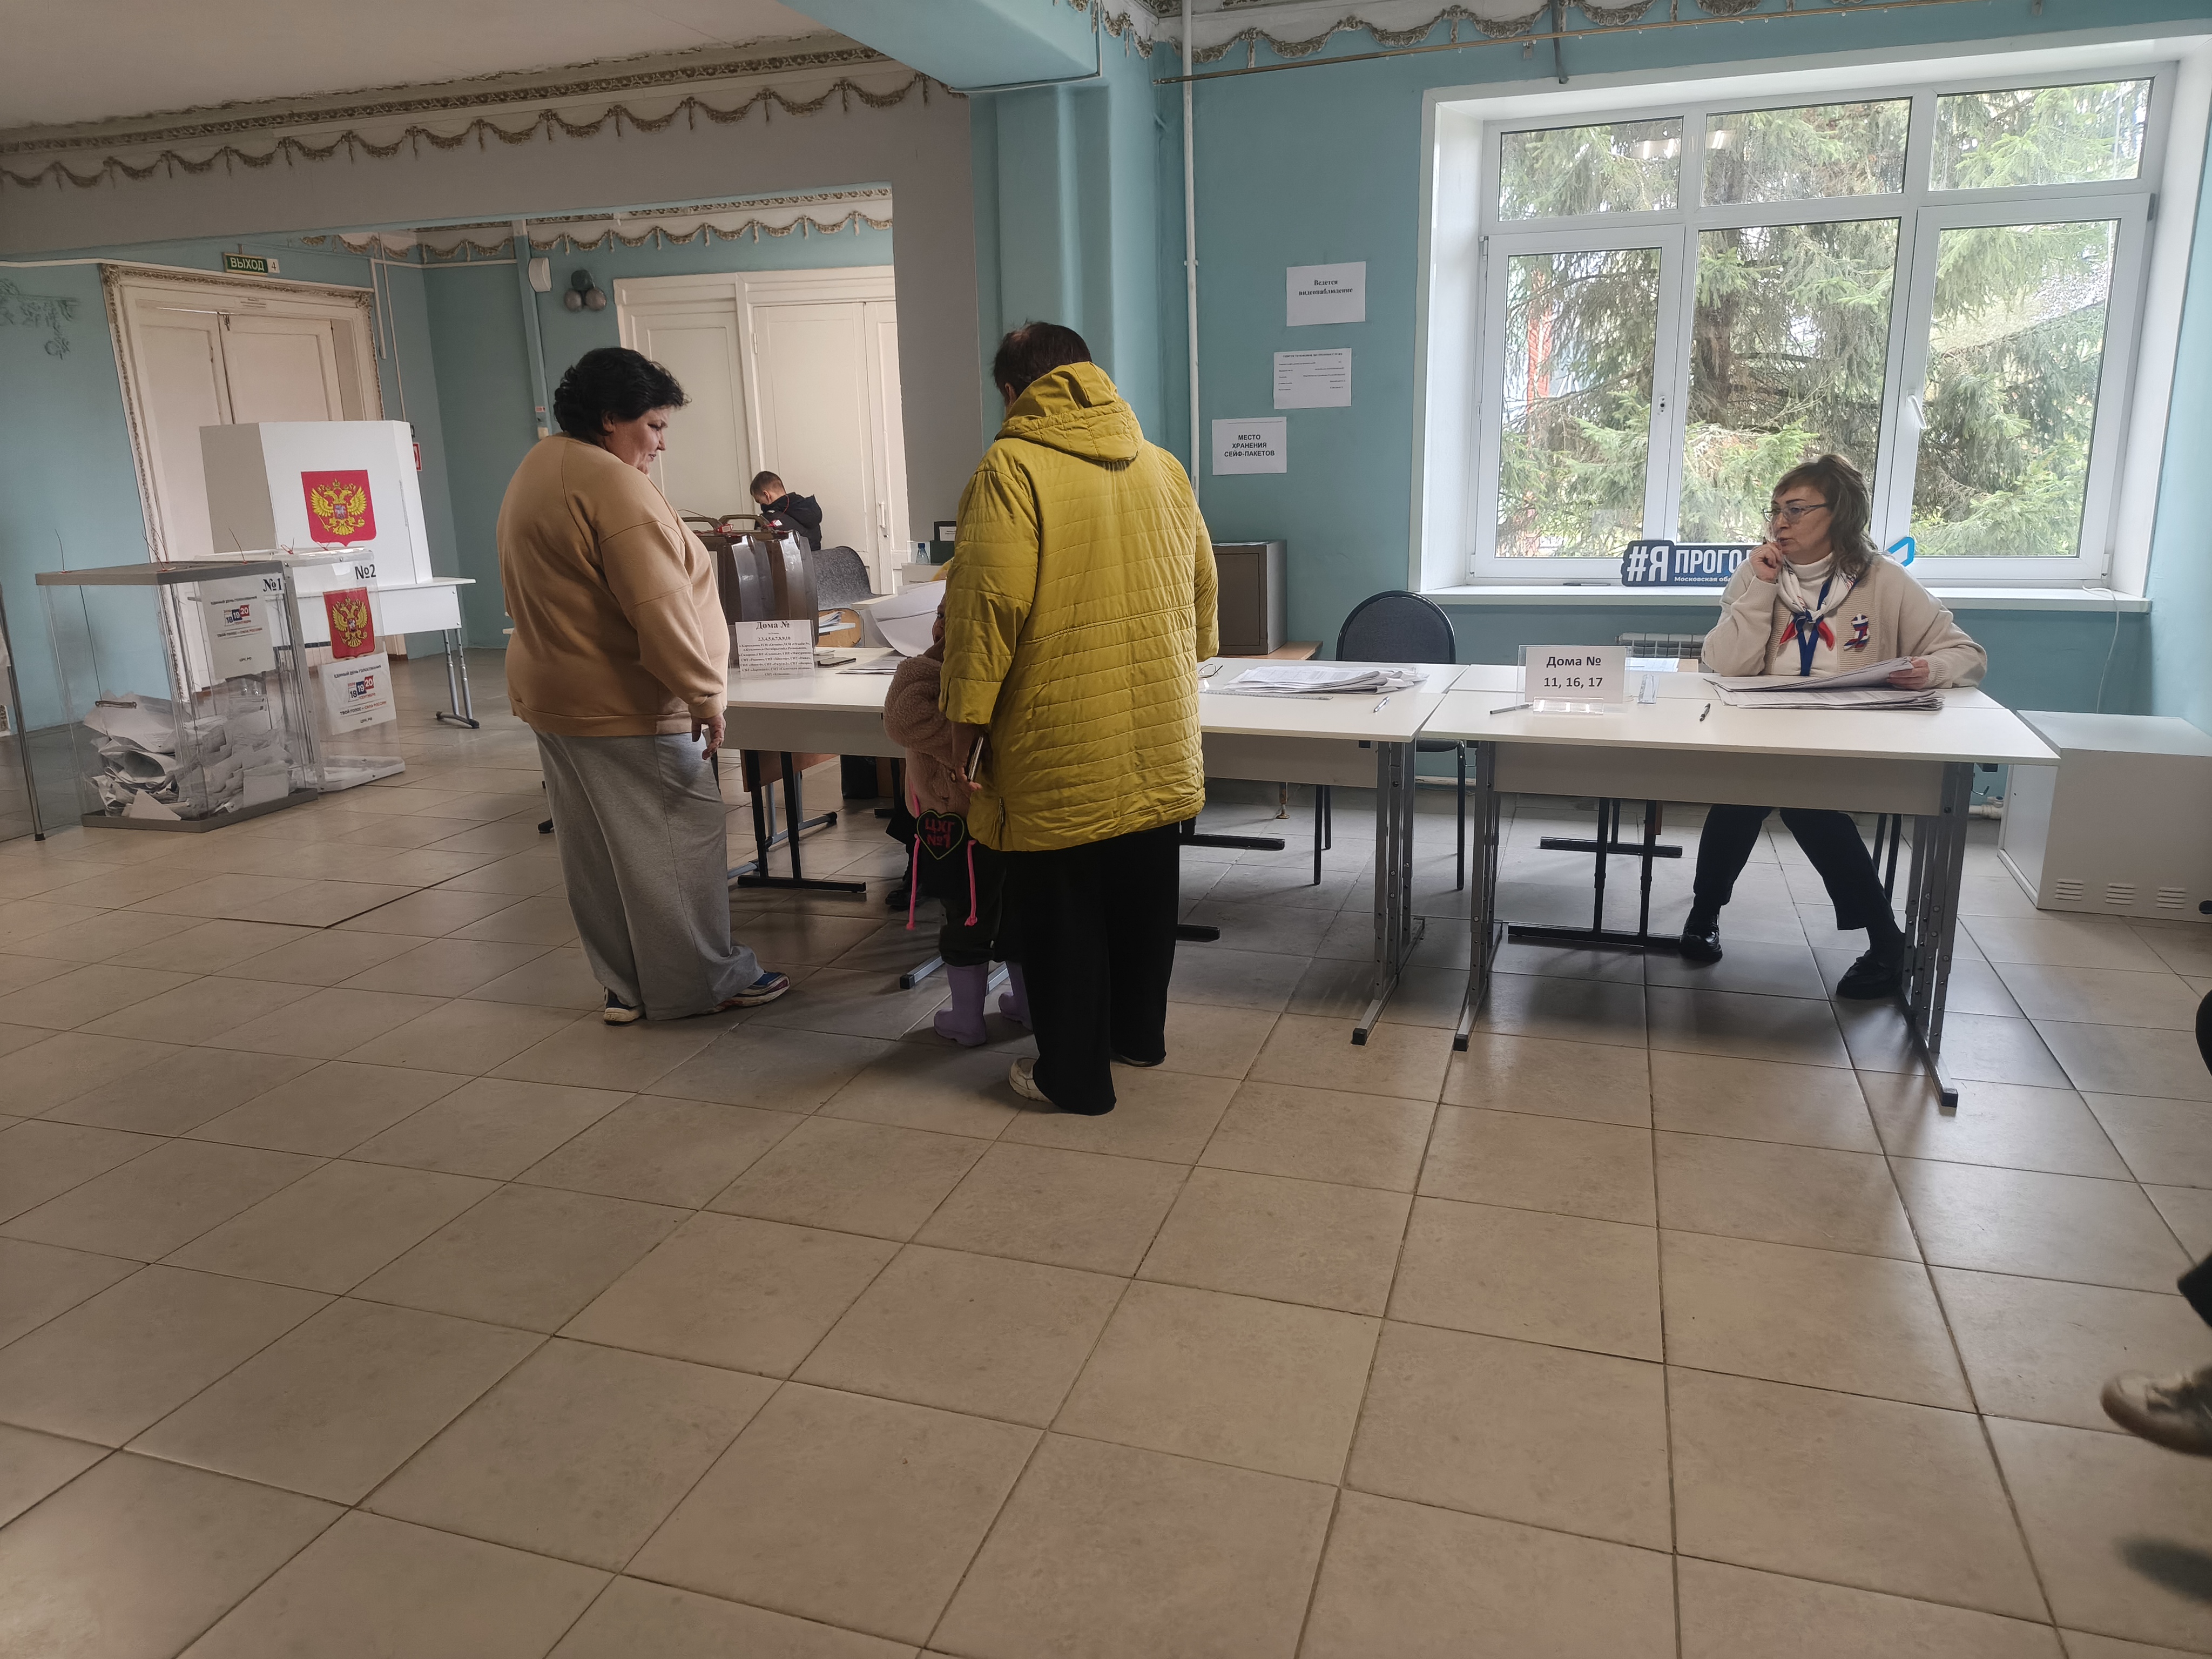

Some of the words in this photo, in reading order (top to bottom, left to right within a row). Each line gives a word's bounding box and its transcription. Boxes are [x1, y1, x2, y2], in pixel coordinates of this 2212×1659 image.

[230, 257, 265, 271] ВЫХОД
[271, 261, 276, 271] 4
[1299, 288, 1353, 296] видеонаблюдение
[1627, 545, 1669, 582] #Я
[354, 564, 376, 579] №2
[262, 578, 282, 592] №1
[756, 622, 779, 630] Дома
[1546, 656, 1582, 668] Дома
[1586, 656, 1601, 666] №
[350, 690, 358, 699] 18
[358, 684, 365, 692] 19
[365, 678, 373, 687] 20
[1544, 677, 1562, 689] 11,
[1566, 677, 1584, 689] 16,
[1588, 677, 1603, 687] 17
[927, 834, 950, 849] №1
